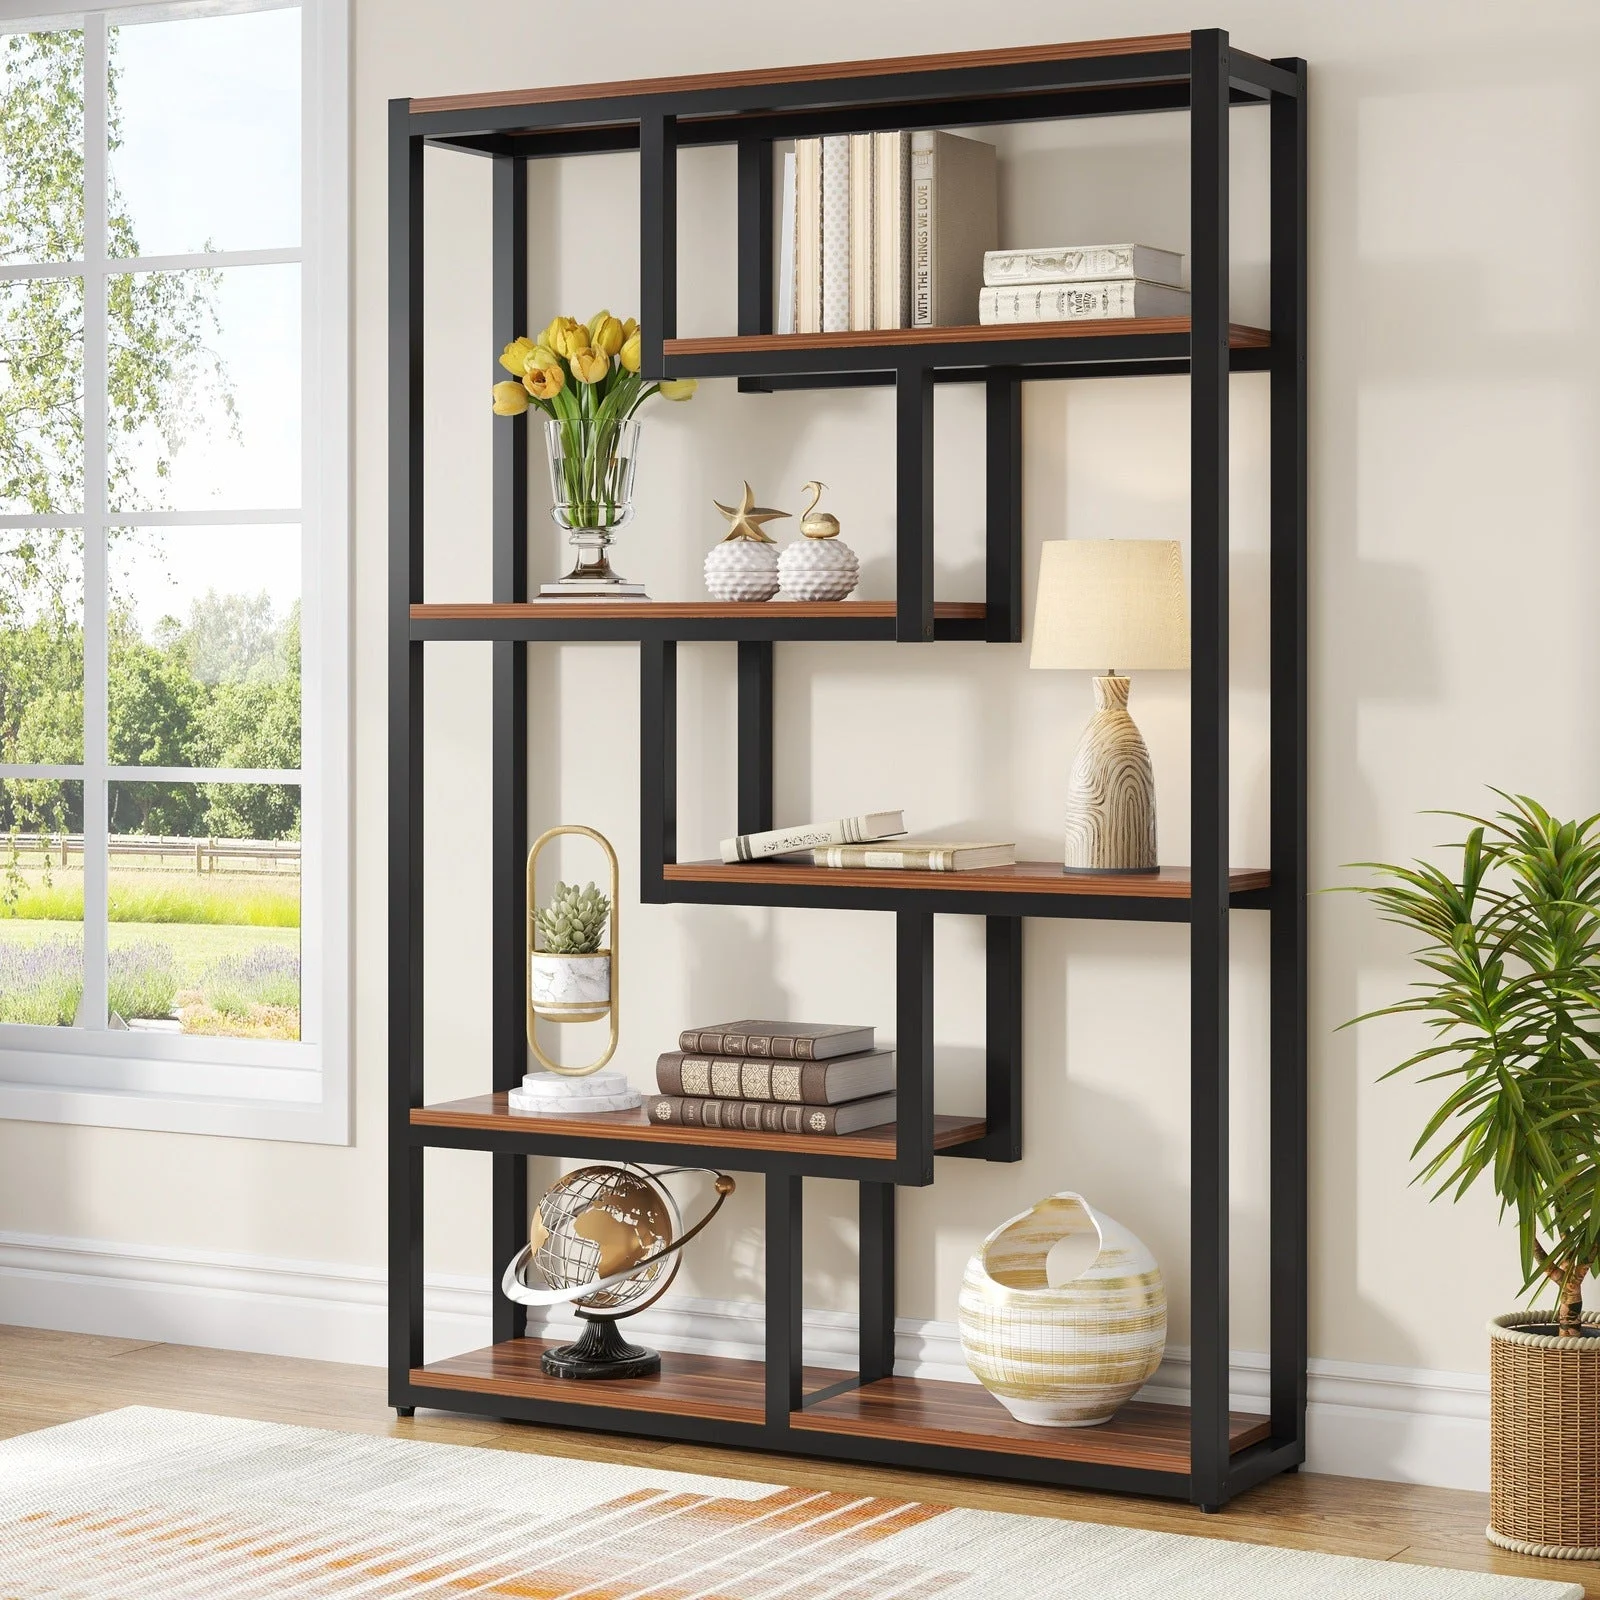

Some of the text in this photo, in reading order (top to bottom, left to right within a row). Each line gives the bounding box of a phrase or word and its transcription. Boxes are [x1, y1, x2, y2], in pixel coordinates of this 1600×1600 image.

[917, 185, 928, 320] WITH THE THINGS WE LOVE
